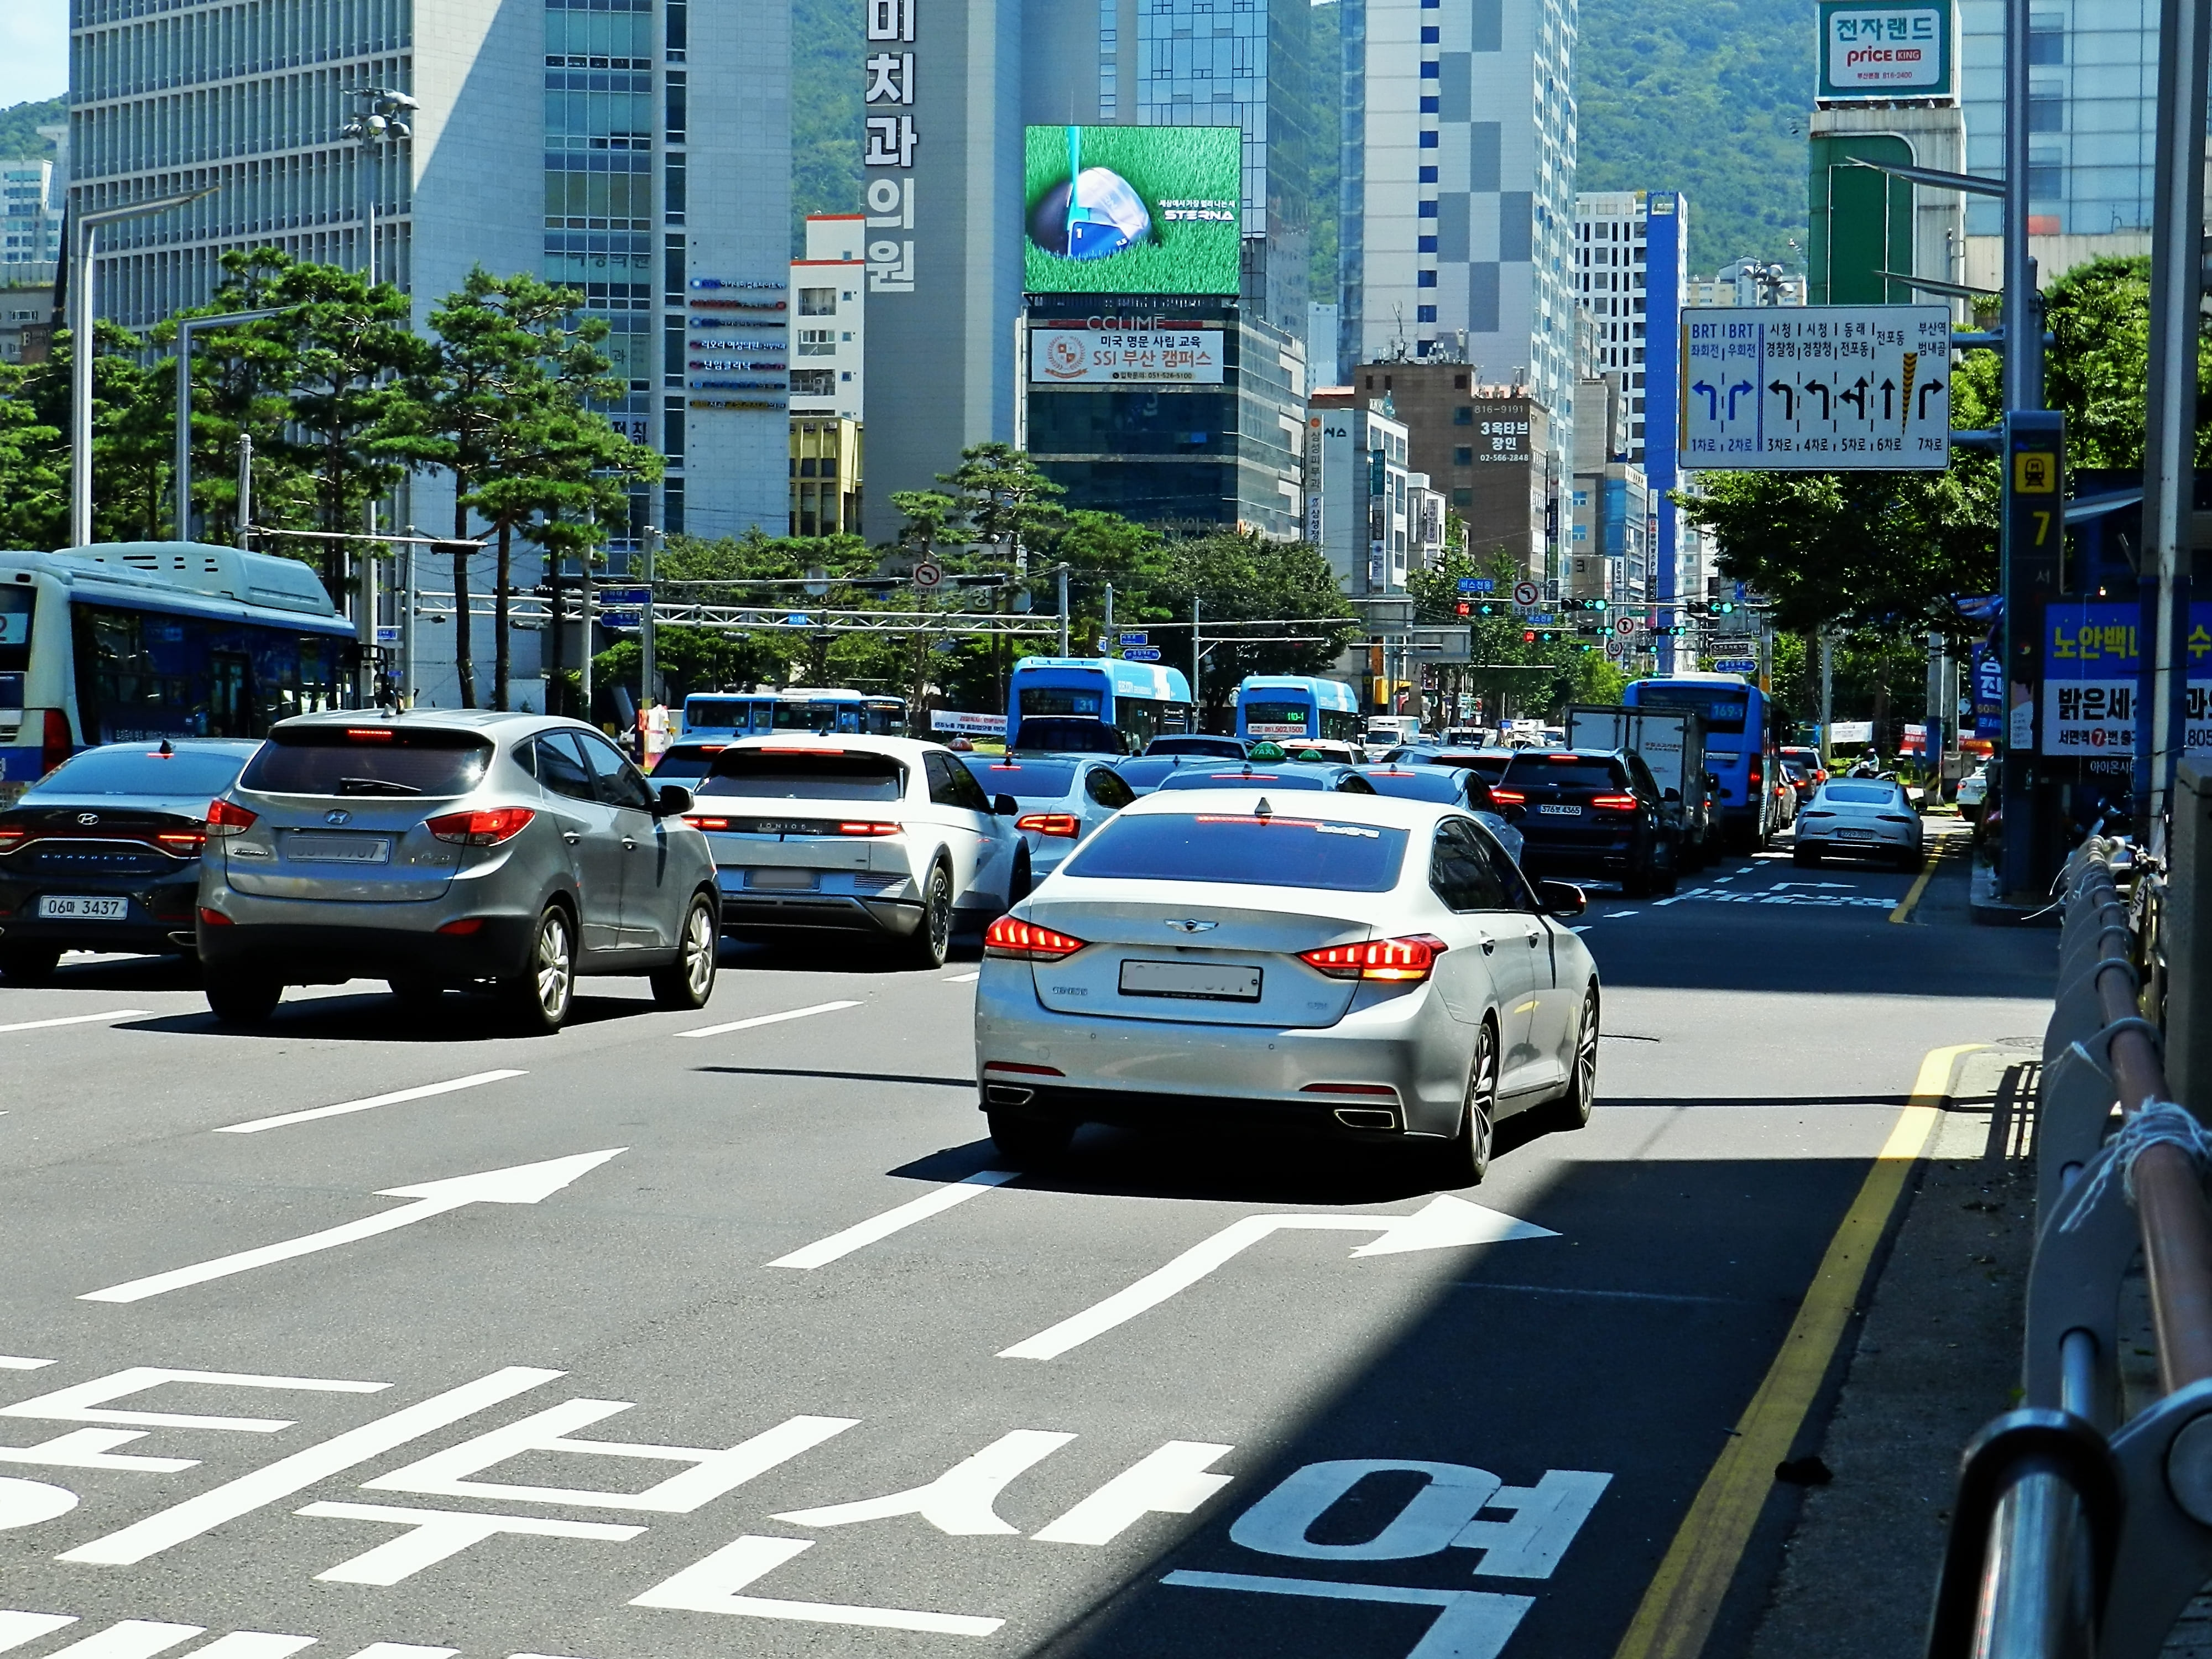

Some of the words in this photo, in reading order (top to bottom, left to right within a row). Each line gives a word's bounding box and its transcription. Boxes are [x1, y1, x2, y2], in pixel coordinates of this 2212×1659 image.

[1837, 17, 1933, 41] 전자랜드
[1897, 50, 1919, 60] KING
[1159, 199, 1185, 207] 세상에서
[1165, 210, 1235, 221] STERNA
[1692, 324, 1718, 338] BRT
[1729, 323, 1754, 338] BRT
[1770, 323, 1791, 338] 시청
[1807, 322, 1827, 338] 시청
[1844, 322, 1865, 338] 동래
[1918, 322, 1946, 336] 부산역
[701, 340, 725, 349] 리오리
[727, 340, 759, 351] 여성의원
[1100, 336, 1123, 348] 미국
[1127, 336, 1149, 348] 명문
[1154, 336, 1175, 348] 사립
[1178, 336, 1202, 348] 교육
[1876, 331, 1905, 346] 전포동
[1691, 345, 1719, 358] 좌회전
[1728, 343, 1756, 358] 우회전
[1766, 342, 1795, 358] 경찰청
[1803, 342, 1832, 357] 경찰청
[1840, 342, 1869, 357] 전포동
[1918, 342, 1946, 357] 범내골
[1093, 351, 1117, 366] SSI
[1122, 350, 1156, 368] 부산
[1162, 350, 1212, 368] 캠퍼스
[1474, 405, 1523, 414] 816-9191
[1480, 421, 1528, 435] 3옥타브
[1492, 437, 1516, 451] 장인
[1692, 439, 1715, 452] 1차로
[1729, 439, 1752, 452] 2차로
[1767, 439, 1792, 452] 3차로
[1804, 438, 1828, 452] 4차로
[1841, 438, 1866, 451] 5차로
[1877, 438, 1902, 451] 6차로
[1918, 437, 1942, 451] 7차로
[1311, 431, 1321, 488] 삼성피부과
[2032, 511, 2051, 546] 7
[1461, 580, 1491, 589] 버스전용
[1610, 644, 1620, 652] 50
[1079, 700, 1093, 711] 31
[49, 900, 75, 914] 06마
[82, 900, 119, 915] 3437
